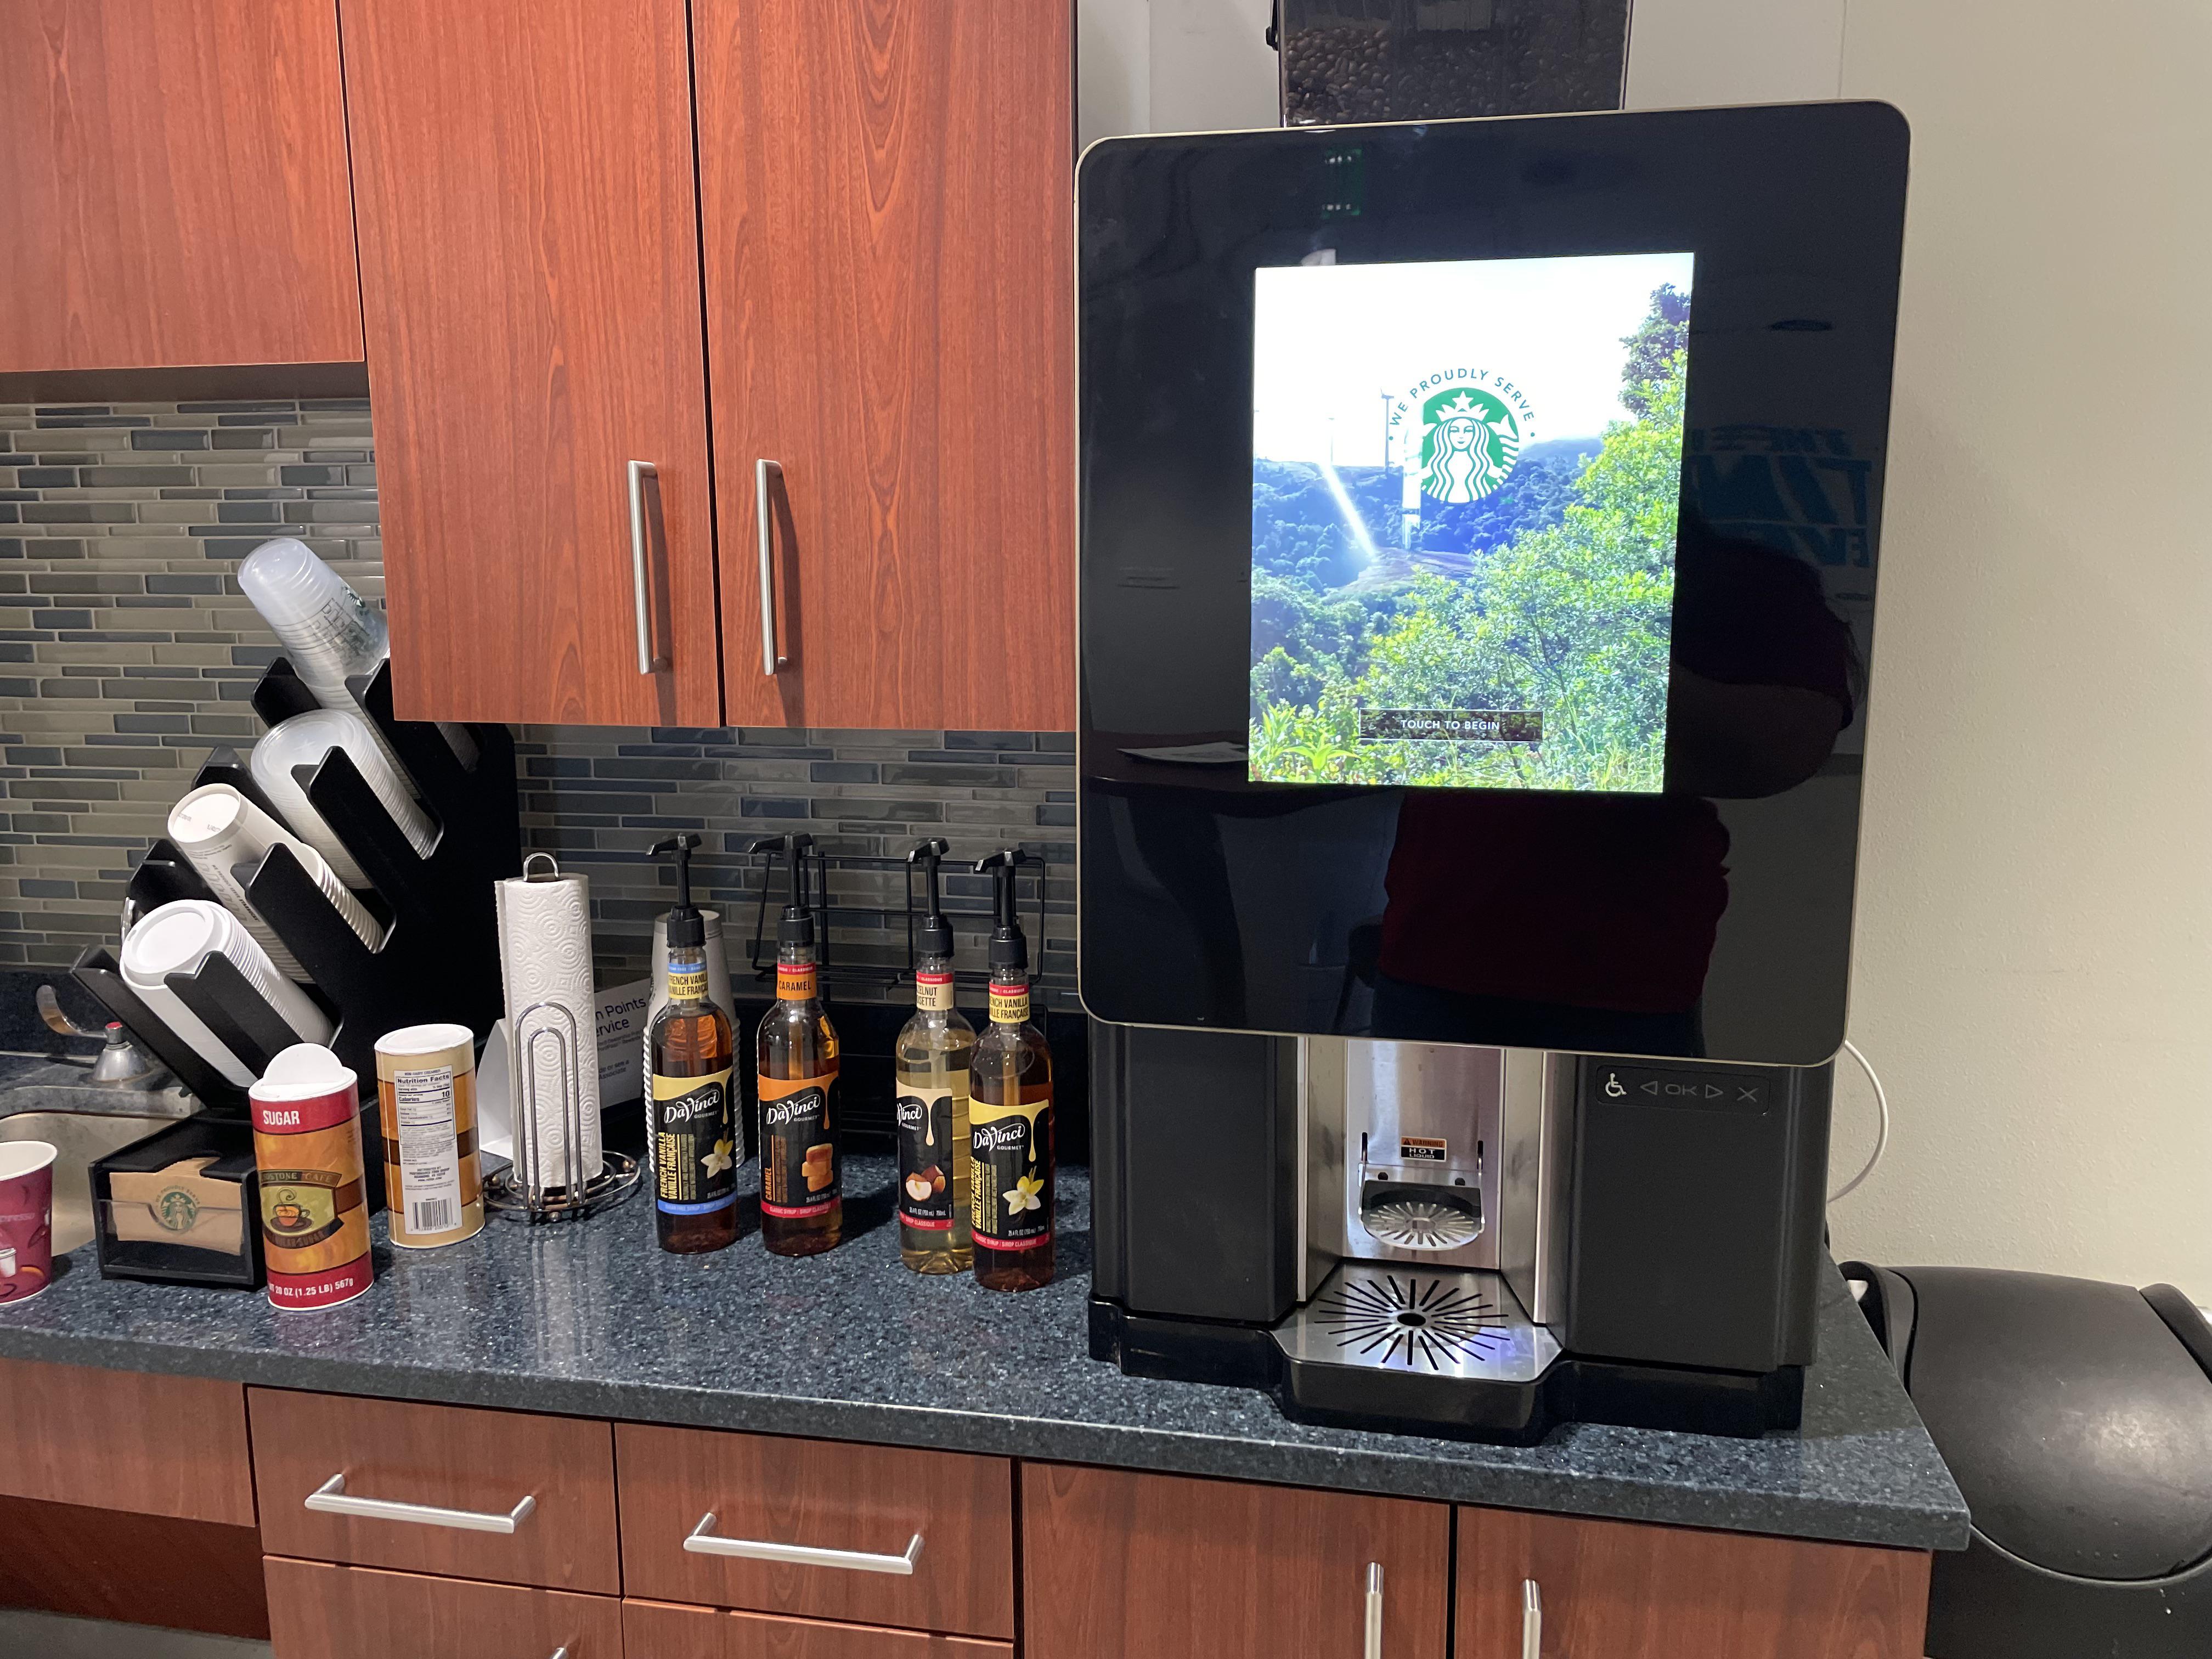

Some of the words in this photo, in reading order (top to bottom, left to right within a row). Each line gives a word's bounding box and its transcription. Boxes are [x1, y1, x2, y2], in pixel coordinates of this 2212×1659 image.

[1389, 402, 1408, 426] WE
[1409, 368, 1489, 399] PROUDLY
[1494, 377, 1534, 421] SERVE
[1400, 719, 1440, 730] TOUCH
[1444, 720, 1460, 730] TO
[1464, 721, 1500, 730] BEGIN
[778, 980, 811, 991] CARAMEL
[605, 997, 646, 1017] Points
[1004, 996, 1028, 1008] VANILLA
[1665, 1084, 1697, 1096] OK
[664, 1089, 720, 1124] DaVinci
[766, 1094, 821, 1125] DaVinci
[263, 1110, 300, 1125] SUGAR
[973, 1123, 1025, 1152] DaVinci
[1412, 1139, 1443, 1147] WARNING
[658, 1132, 666, 1165] VANILLA
[659, 1166, 668, 1198] FRENCH
[667, 1171, 678, 1199] VANILLE
[284, 1287, 294, 1296] OZ
[295, 1286, 317, 1298] (1.25
[319, 1283, 332, 1293] LB)
